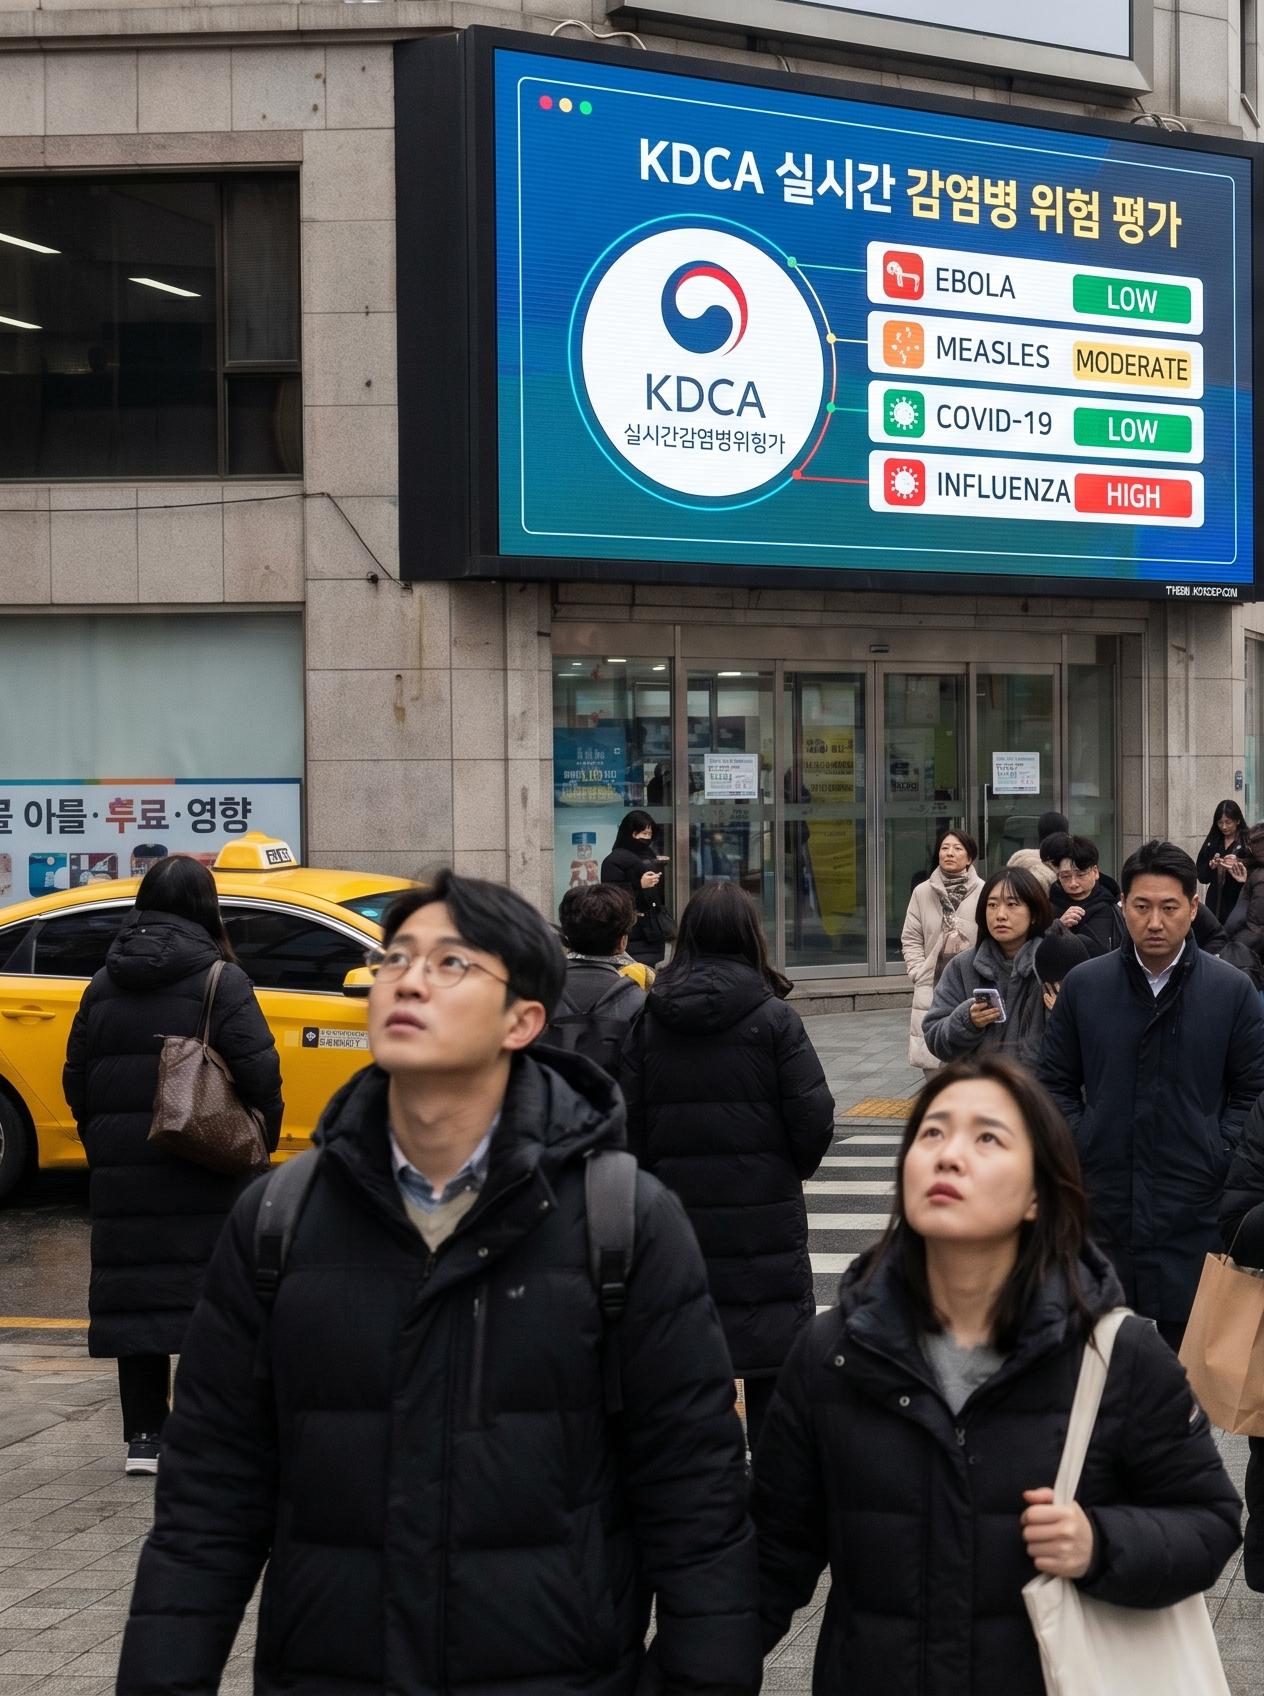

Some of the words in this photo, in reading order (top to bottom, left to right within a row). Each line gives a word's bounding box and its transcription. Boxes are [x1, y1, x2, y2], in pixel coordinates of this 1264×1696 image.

[640, 137, 765, 195] KDCA
[775, 151, 896, 214] 실시간
[906, 168, 1018, 230] 감염병
[1030, 184, 1100, 240] 위험
[1112, 195, 1183, 249] 평가
[936, 266, 1016, 299] EBOLA
[1107, 284, 1158, 314] LOW
[936, 335, 1050, 369] MEASLES
[1076, 348, 1188, 381] MODERATE
[646, 373, 767, 419] KDCA
[937, 404, 1052, 436] COVID-19
[1108, 416, 1158, 444] LOW
[938, 472, 1071, 504] INFLUENZA
[1107, 482, 1161, 509] HIGH
